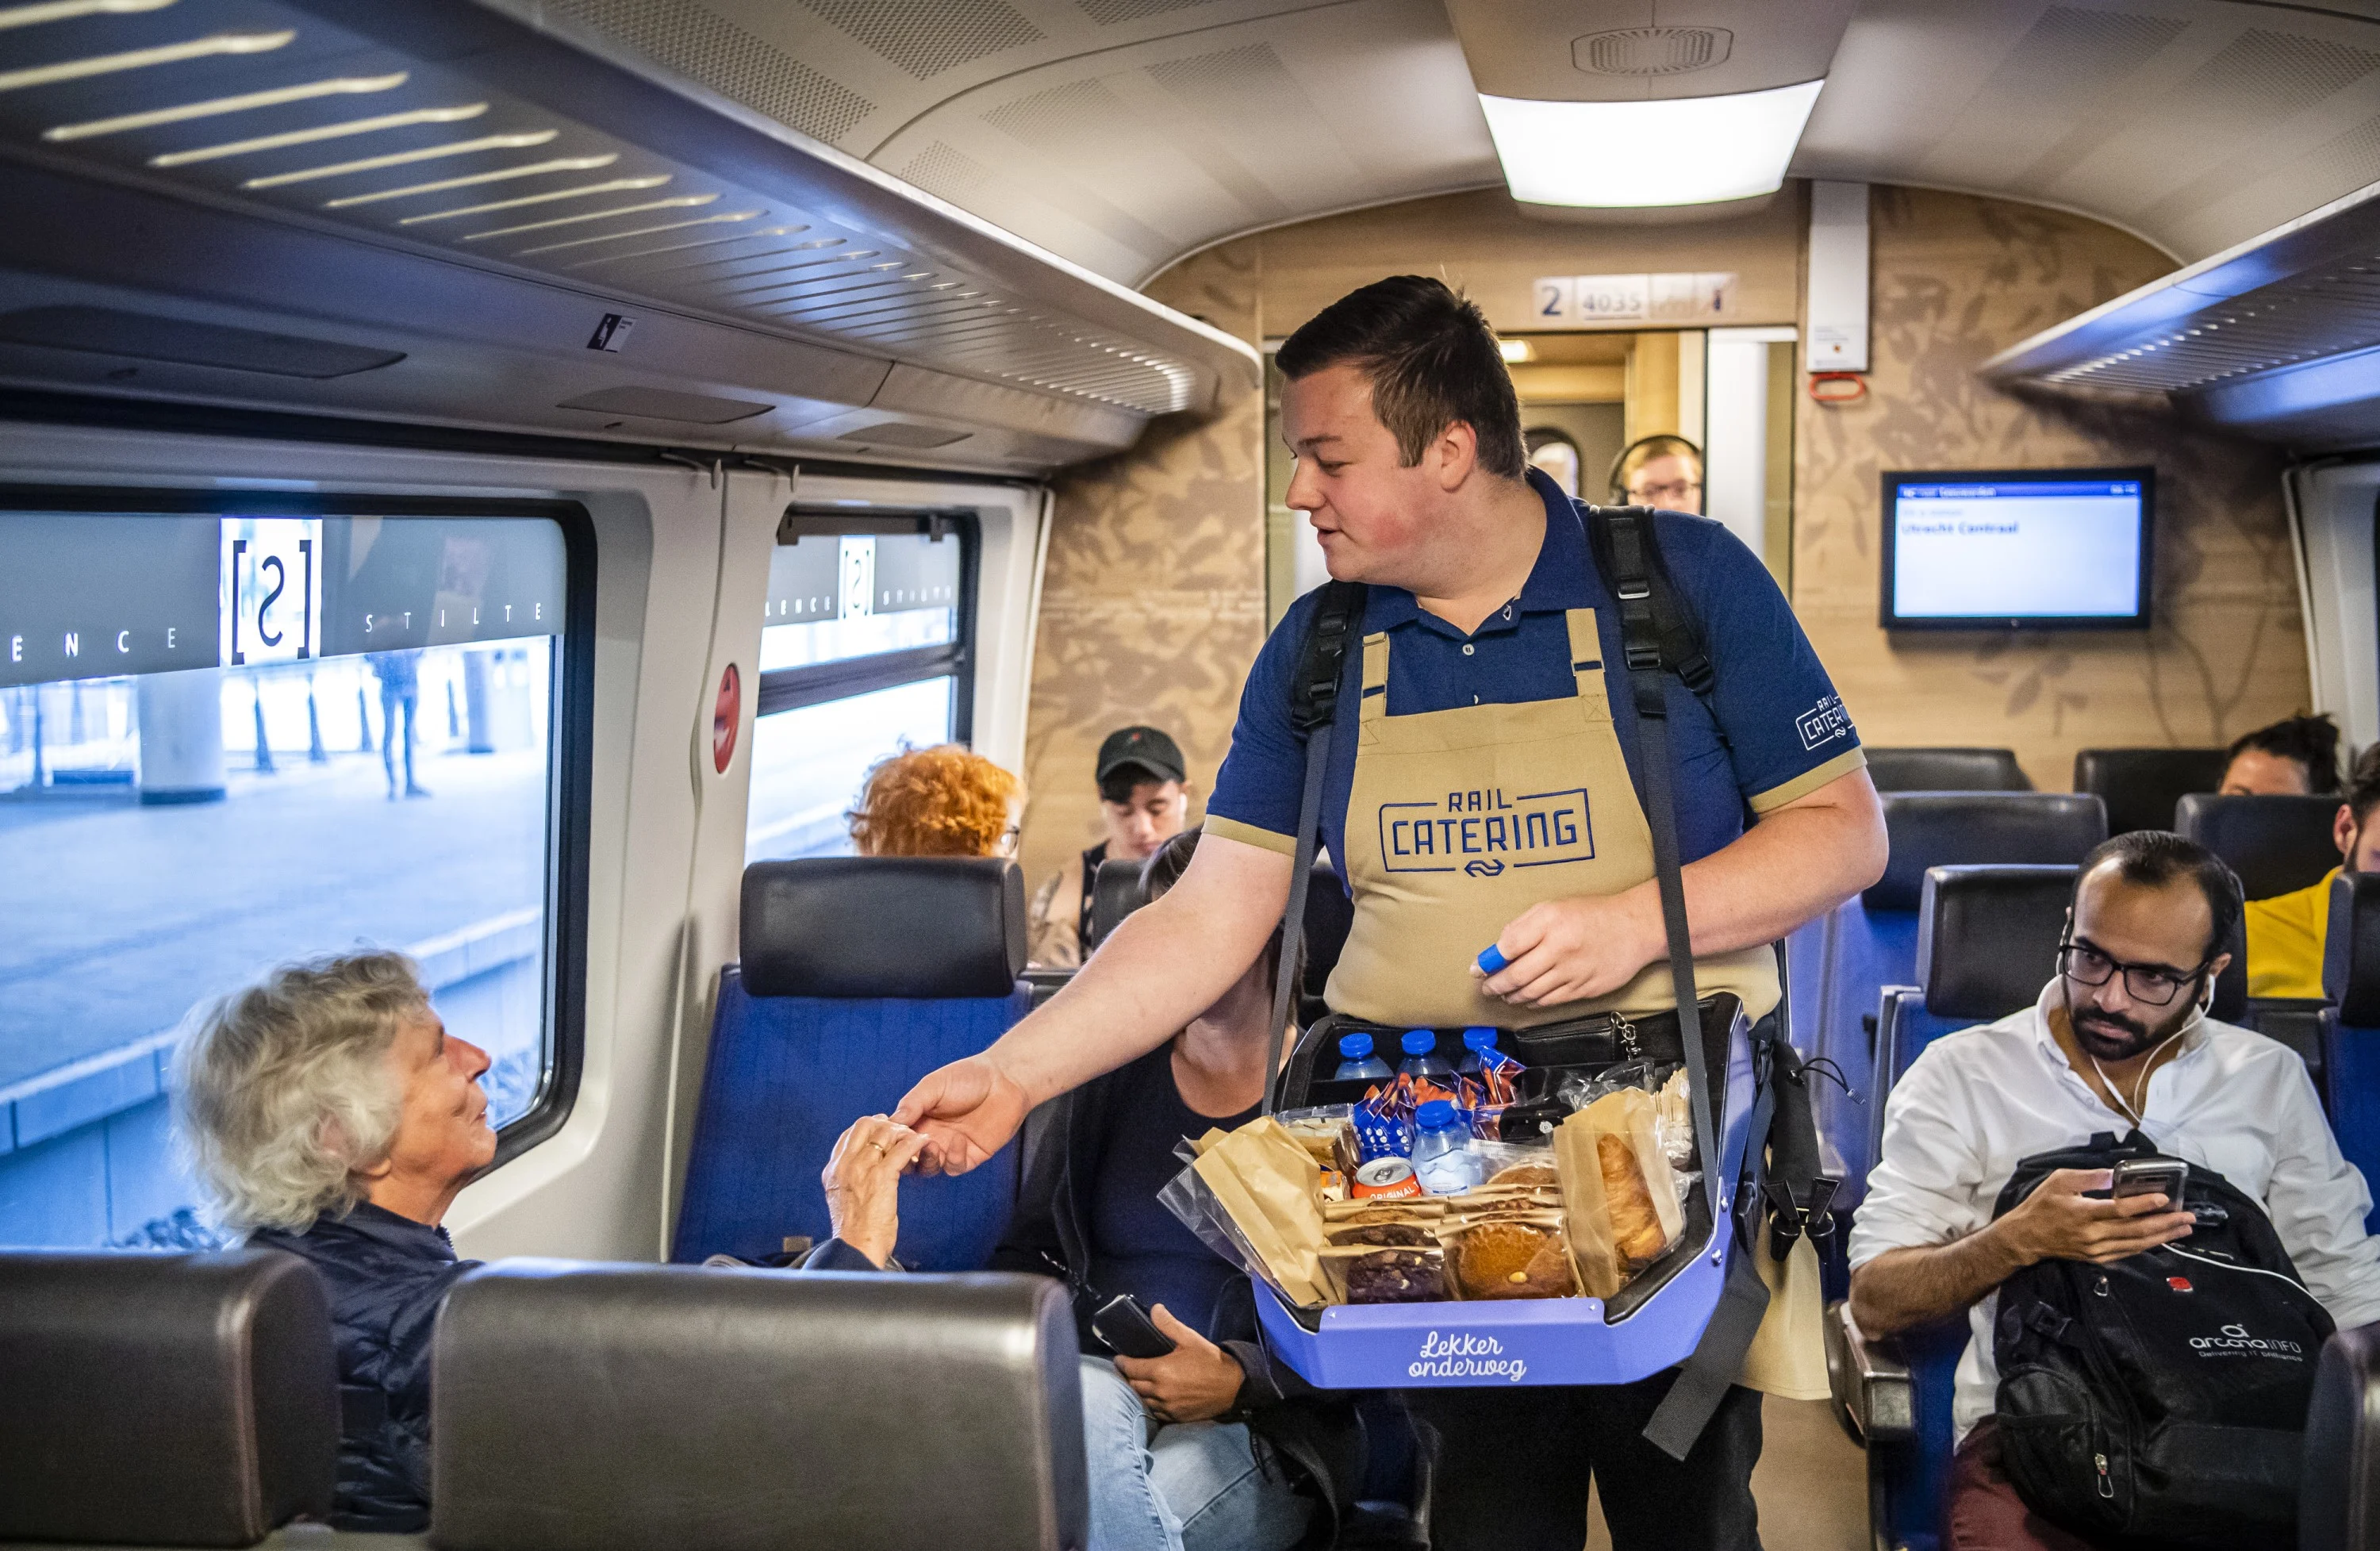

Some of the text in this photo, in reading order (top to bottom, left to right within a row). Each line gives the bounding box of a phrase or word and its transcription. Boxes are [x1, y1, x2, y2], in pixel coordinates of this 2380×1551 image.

[1541, 286, 1562, 316] 2
[366, 602, 542, 633] STILTE
[1817, 694, 1837, 712] RAIL
[1449, 789, 1512, 812] RAIL
[1392, 809, 1577, 854] CATERING
[1420, 1330, 1503, 1358] Lekker
[1408, 1356, 1527, 1382] onderweg
